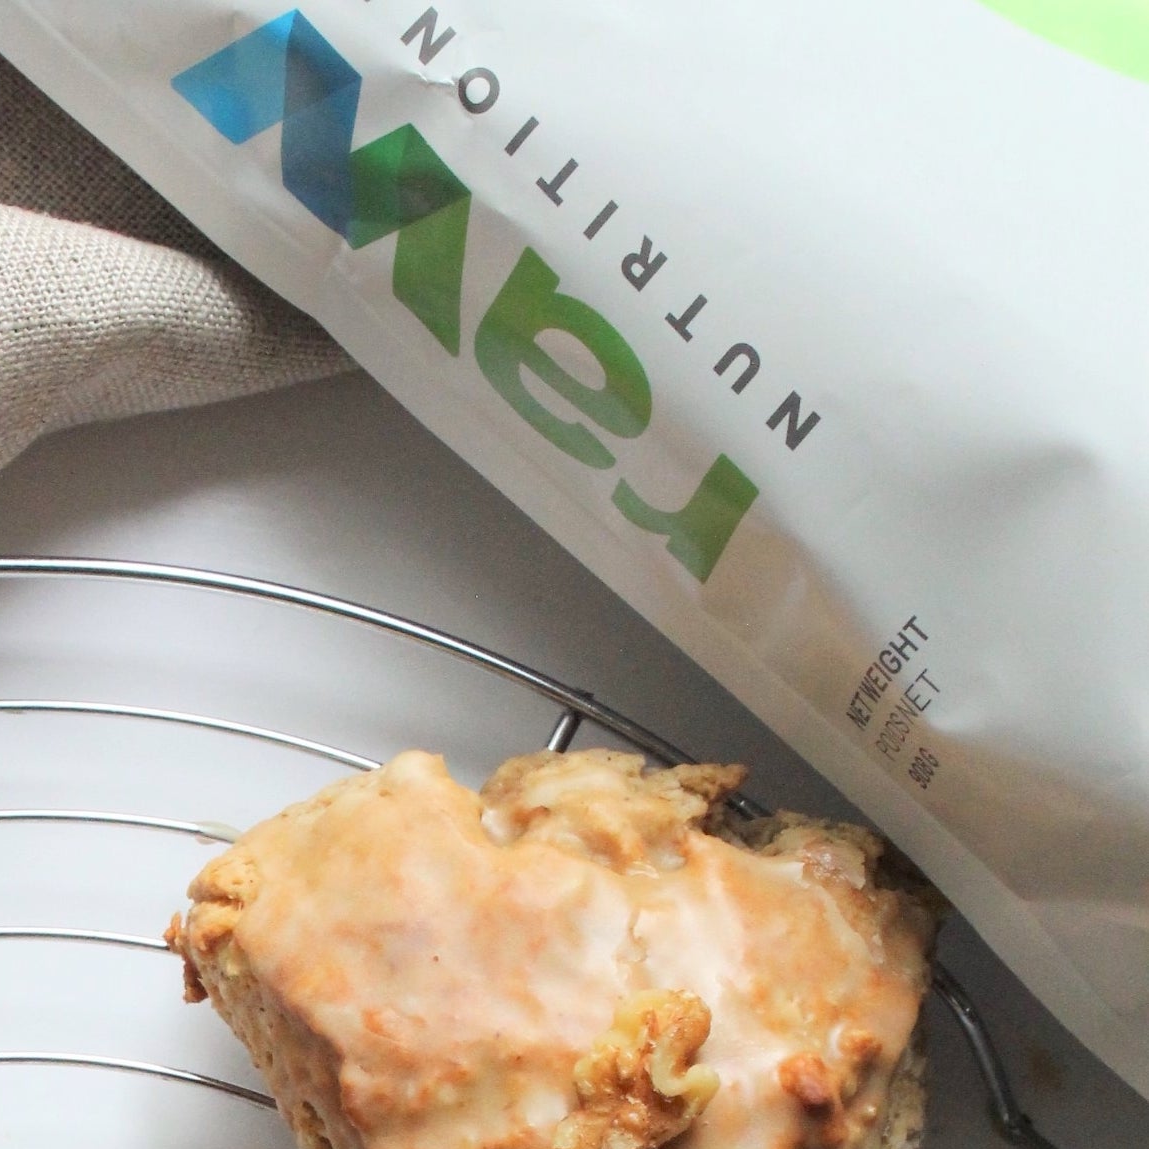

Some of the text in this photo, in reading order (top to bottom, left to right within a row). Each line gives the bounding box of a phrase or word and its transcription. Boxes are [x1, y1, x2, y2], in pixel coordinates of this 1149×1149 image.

[362, 0, 822, 452] NUTRITION
[845, 614, 929, 732] NET WEIGHT
[874, 667, 941, 762] POIDS NET
